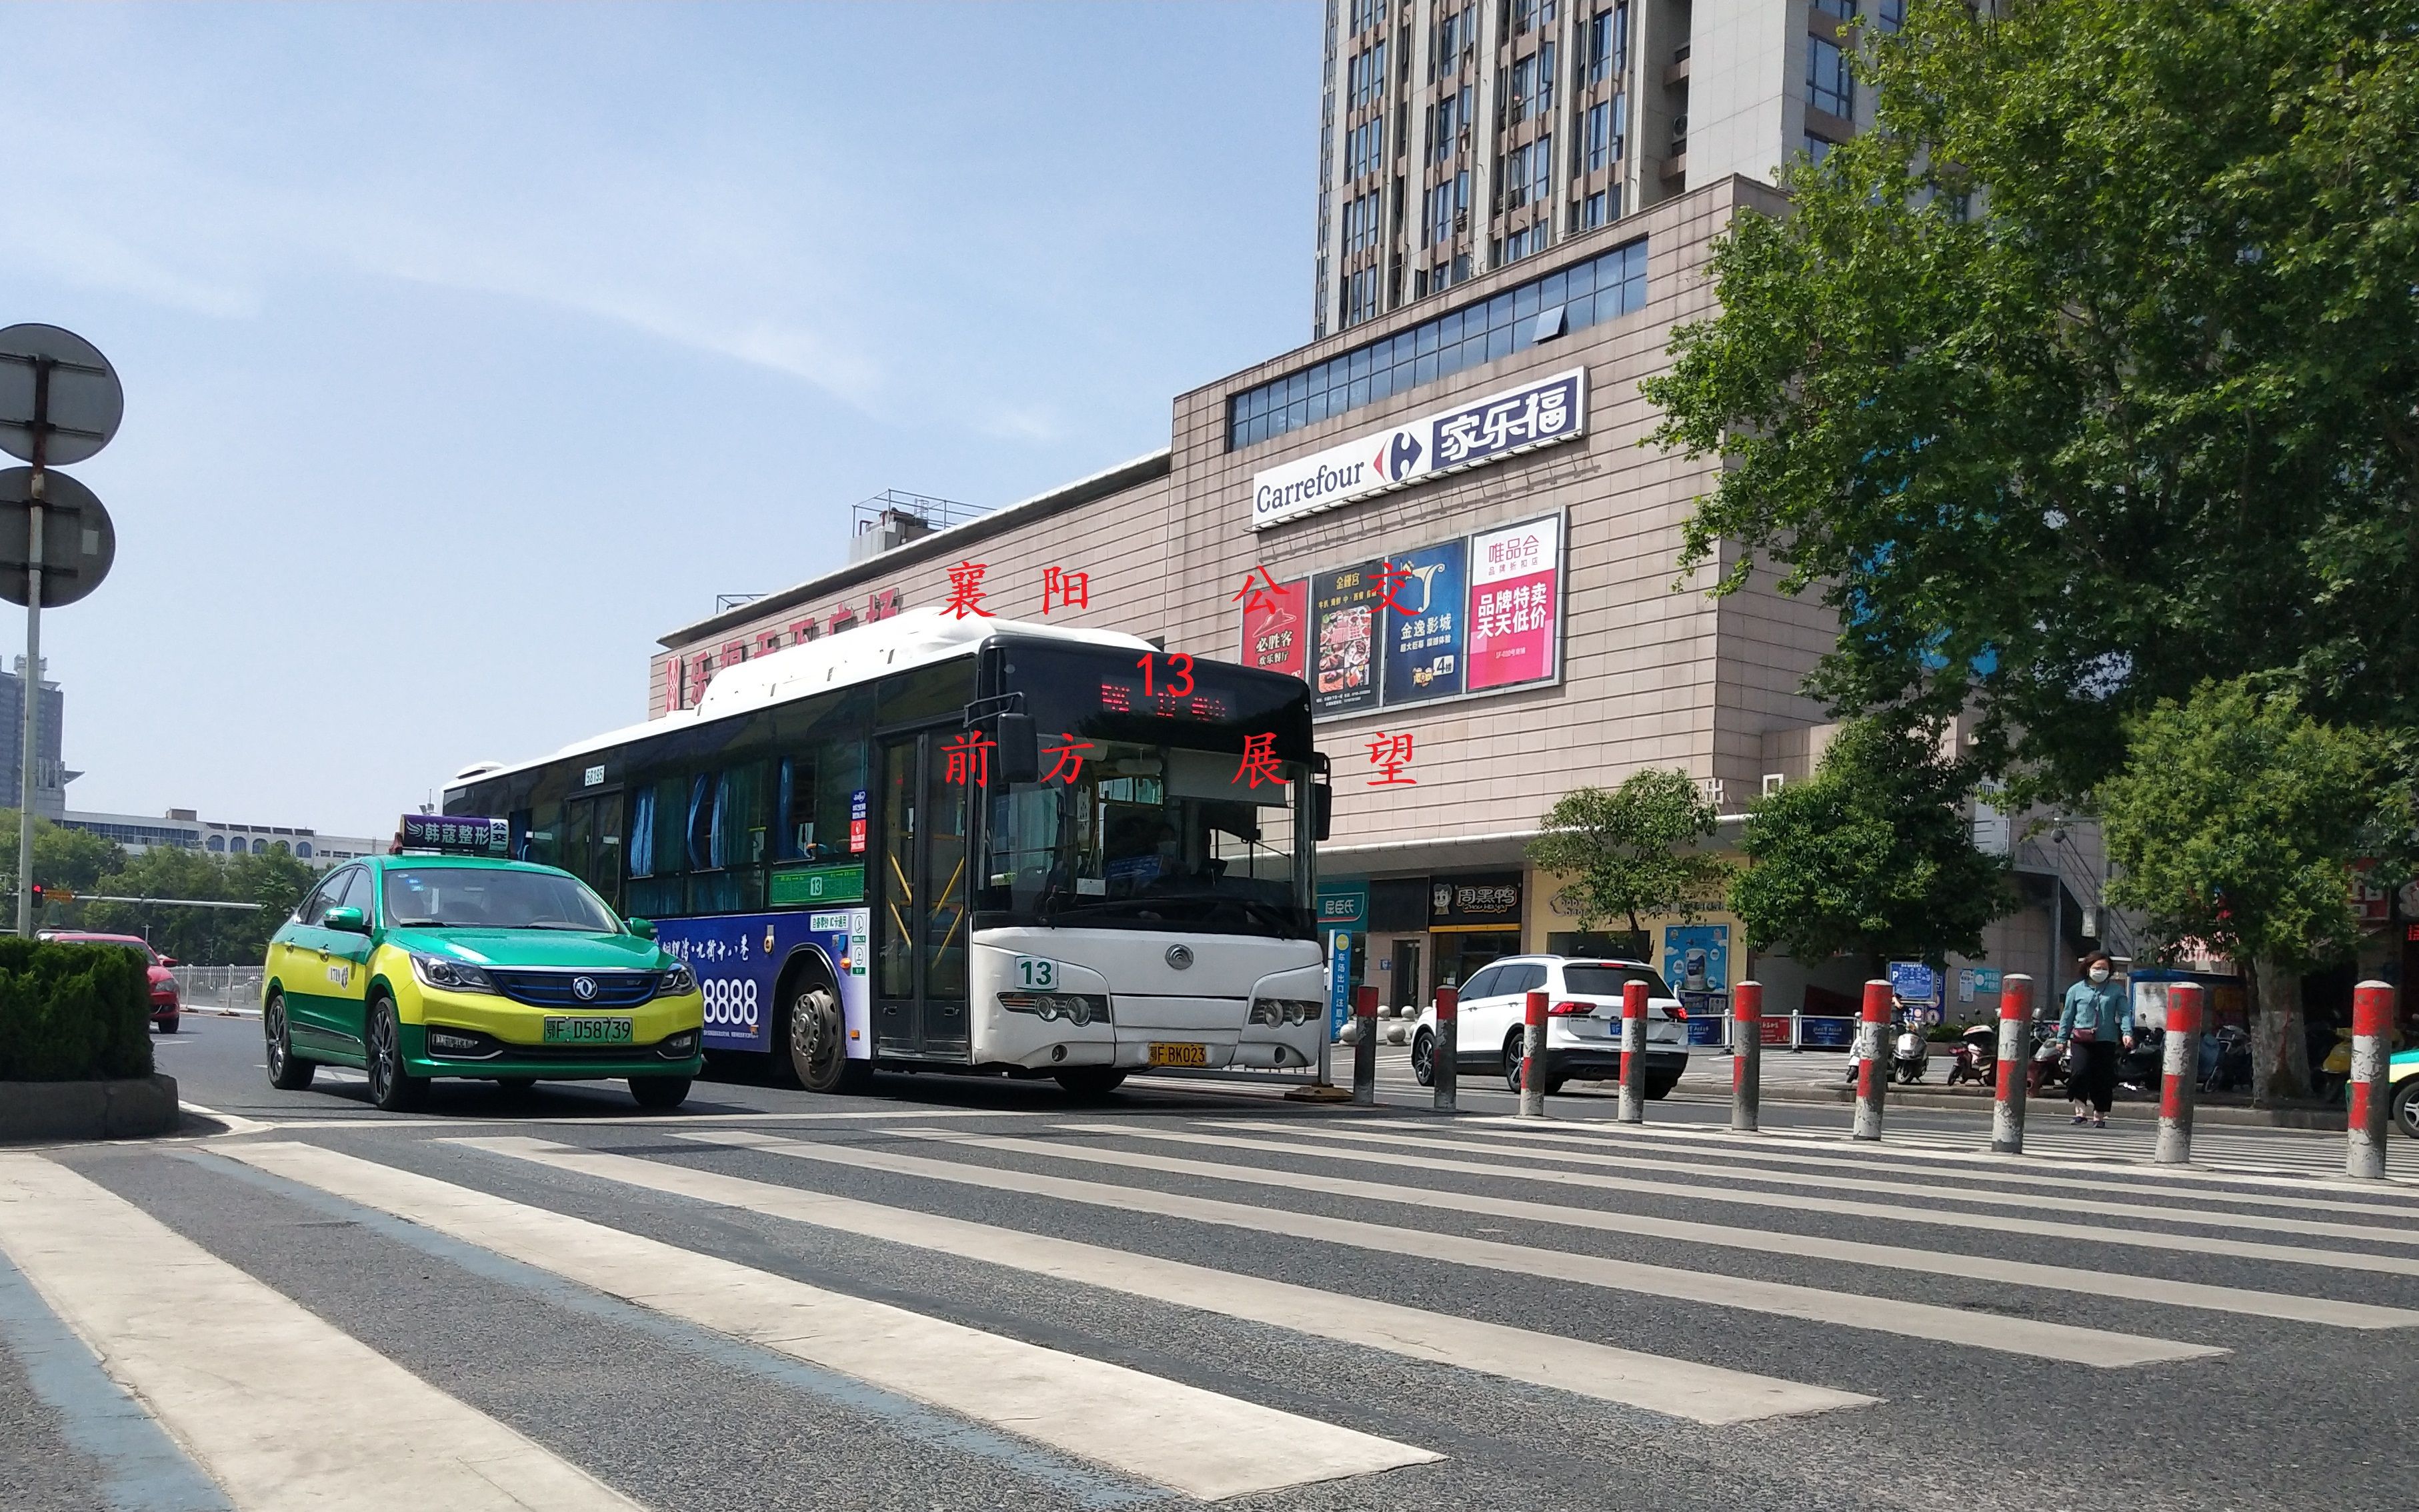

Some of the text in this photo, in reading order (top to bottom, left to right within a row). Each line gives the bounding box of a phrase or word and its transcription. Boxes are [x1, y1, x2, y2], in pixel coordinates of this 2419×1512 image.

[1440, 386, 1567, 461] 家乐福
[1257, 461, 1364, 513] Carrefour
[1488, 535, 1539, 564] 唯品会
[1488, 557, 1538, 575] 品牌折扣店
[1478, 582, 1547, 617] 品牌特卖
[1401, 613, 1452, 640] 金逸影城
[1476, 605, 1546, 639] 天天低价
[1256, 630, 1293, 652] 必胜客
[1260, 651, 1290, 666] 欢乐餐厅
[586, 768, 603, 784] 58195
[425, 822, 489, 845] 韩蔻整形
[493, 822, 507, 842] 公交
[812, 879, 821, 894] 13
[1458, 887, 1515, 903] 周黑鸭
[1326, 899, 1354, 915] 屈臣氏
[1020, 961, 1051, 985] 13
[1892, 971, 1899, 981] P
[703, 979, 758, 1025] 8888
[573, 1021, 631, 1039] D58739
[1168, 1047, 1205, 1063] BK023
